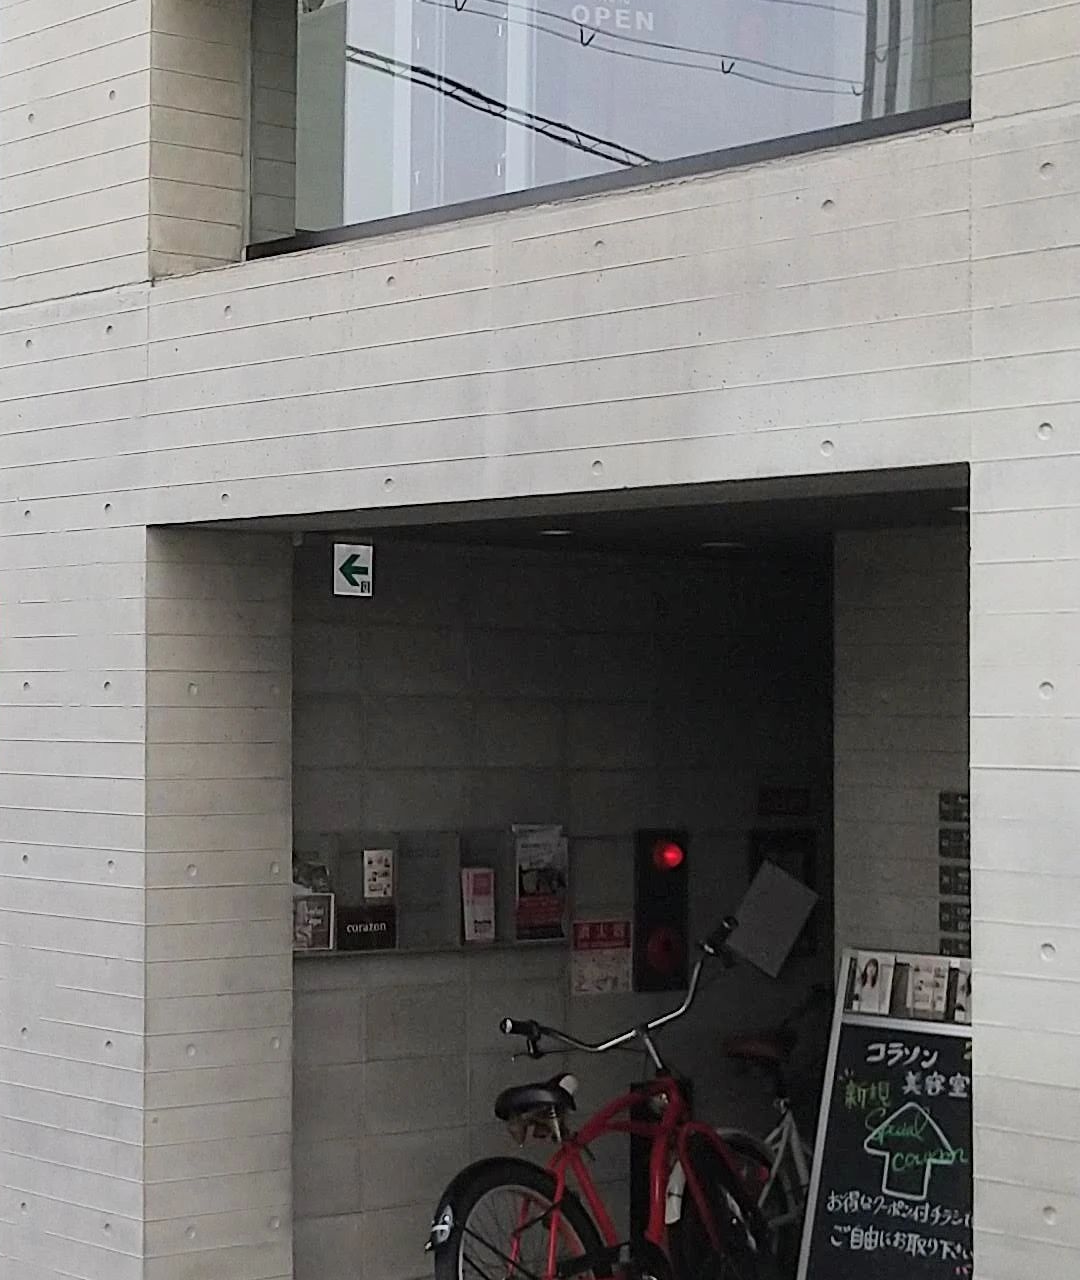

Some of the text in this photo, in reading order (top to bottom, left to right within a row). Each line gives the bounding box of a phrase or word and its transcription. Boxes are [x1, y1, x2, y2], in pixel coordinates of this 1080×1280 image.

[571, 4, 654, 31] OPEN
[866, 1042, 939, 1069] コラソン
[902, 1070, 971, 1098] 美容室
